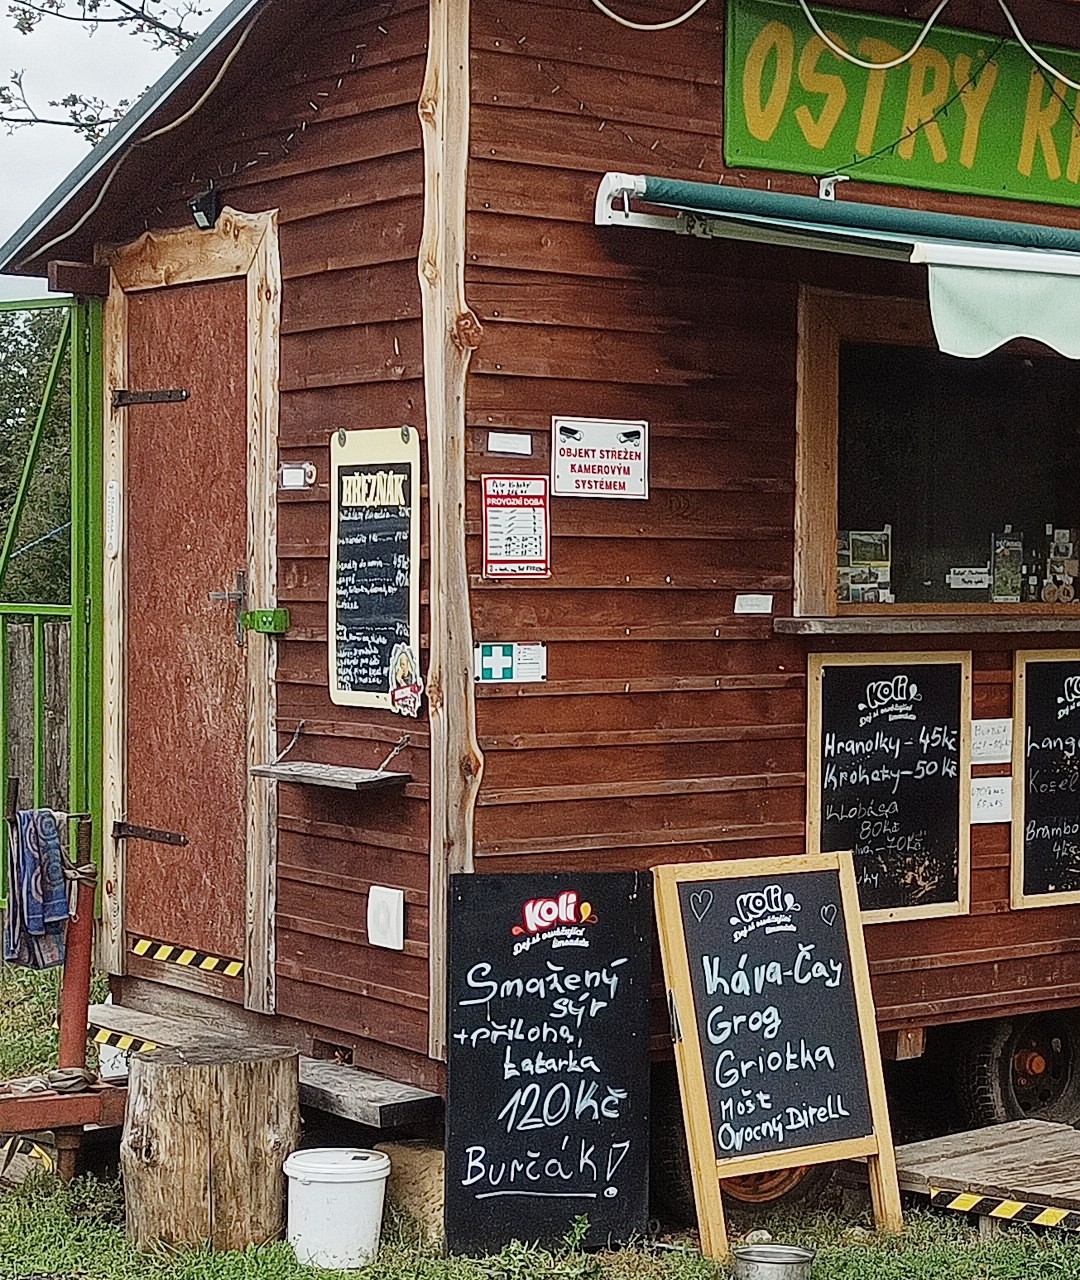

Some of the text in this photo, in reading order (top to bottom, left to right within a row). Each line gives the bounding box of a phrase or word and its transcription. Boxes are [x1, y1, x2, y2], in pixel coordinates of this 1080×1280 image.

[559, 447, 597, 459] OBJEKT
[570, 462, 631, 476] KAMEROVÝM
[574, 477, 626, 491] SYSTÉMEM
[824, 730, 901, 759] Hranolky
[523, 892, 578, 933] Koli
[459, 957, 629, 1006] Smažený
[549, 992, 608, 1029] sýr
[706, 1004, 782, 1045] Grog
[503, 1045, 601, 1081] tatarka
[715, 1038, 836, 1089] Griotka
[719, 1088, 773, 1121] Mošt
[717, 1113, 784, 1151] Ovocný
